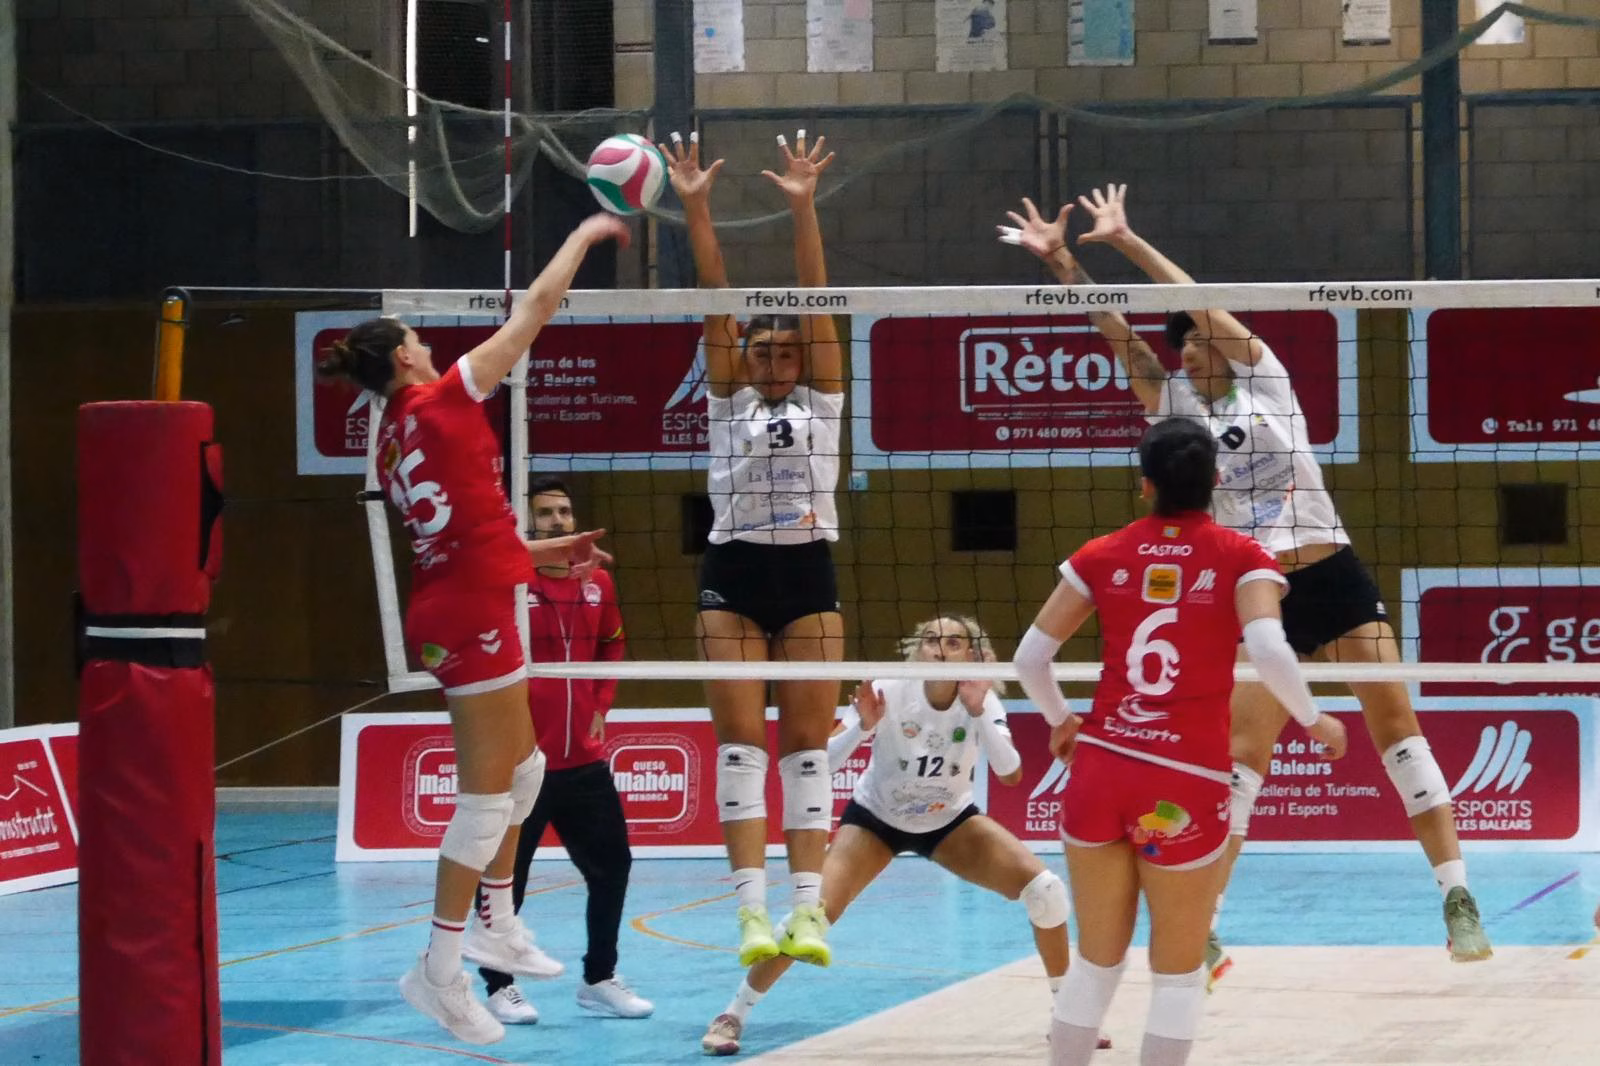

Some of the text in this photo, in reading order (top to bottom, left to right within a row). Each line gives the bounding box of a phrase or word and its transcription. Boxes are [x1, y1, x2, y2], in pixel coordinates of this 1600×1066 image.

[746, 291, 847, 307] rfevb.com
[1026, 289, 1129, 305] rfevb.com
[1309, 285, 1413, 301] rfevb.com
[662, 412, 709, 430] ESPO
[1552, 419, 1578, 431] 971
[767, 419, 795, 449] 3
[1012, 427, 1034, 438] 971
[345, 438, 369, 449] ILLE
[1137, 543, 1194, 557] CASTRO
[1126, 607, 1180, 696] 6
[1287, 739, 1306, 754] de
[632, 760, 667, 771] QUESO
[917, 755, 945, 777] 12
[1270, 759, 1333, 776] Balears
[613, 770, 684, 792] mahón
[1305, 784, 1322, 797] de
[1325, 782, 1380, 799] Turisme,
[1288, 801, 1339, 818] Esports
[1026, 820, 1057, 831] ILLES
[1478, 819, 1533, 831] BALEARS
